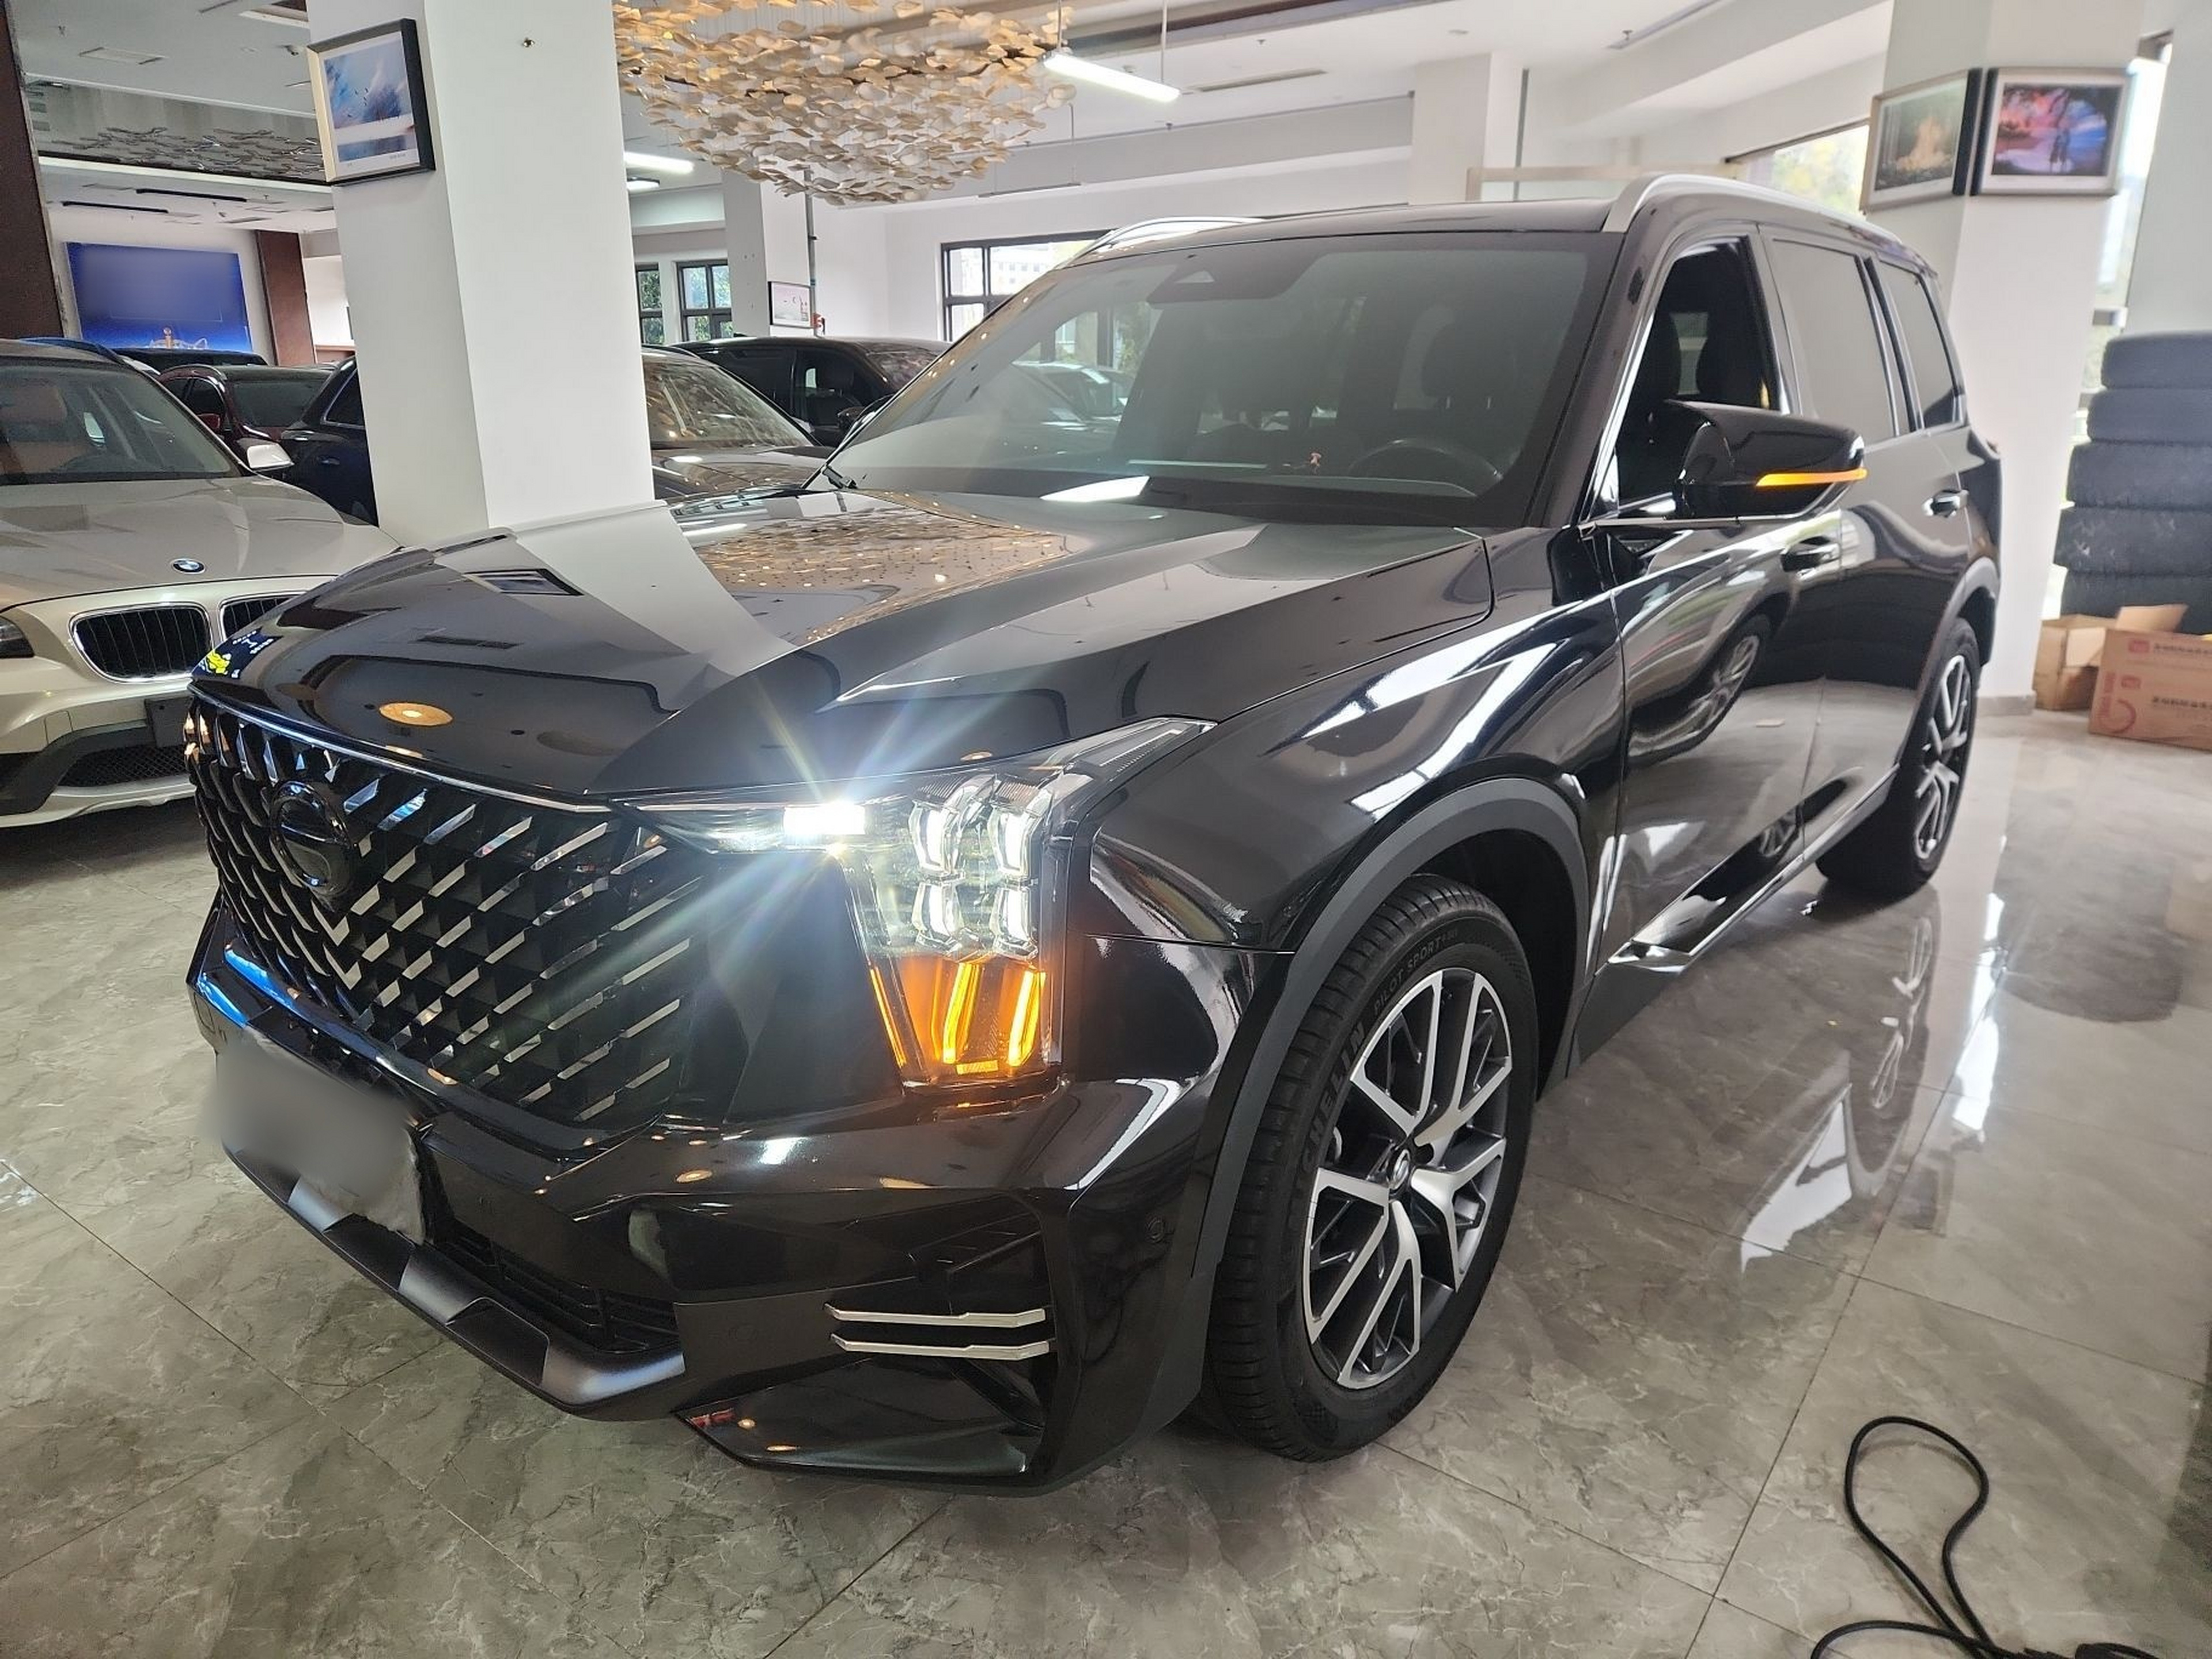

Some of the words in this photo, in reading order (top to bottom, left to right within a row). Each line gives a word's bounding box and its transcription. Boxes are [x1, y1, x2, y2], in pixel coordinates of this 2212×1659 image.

[1374, 969, 1404, 1015] PILOT
[1407, 937, 1441, 969] SPORT
[1290, 1021, 1365, 1222] CHELIN
